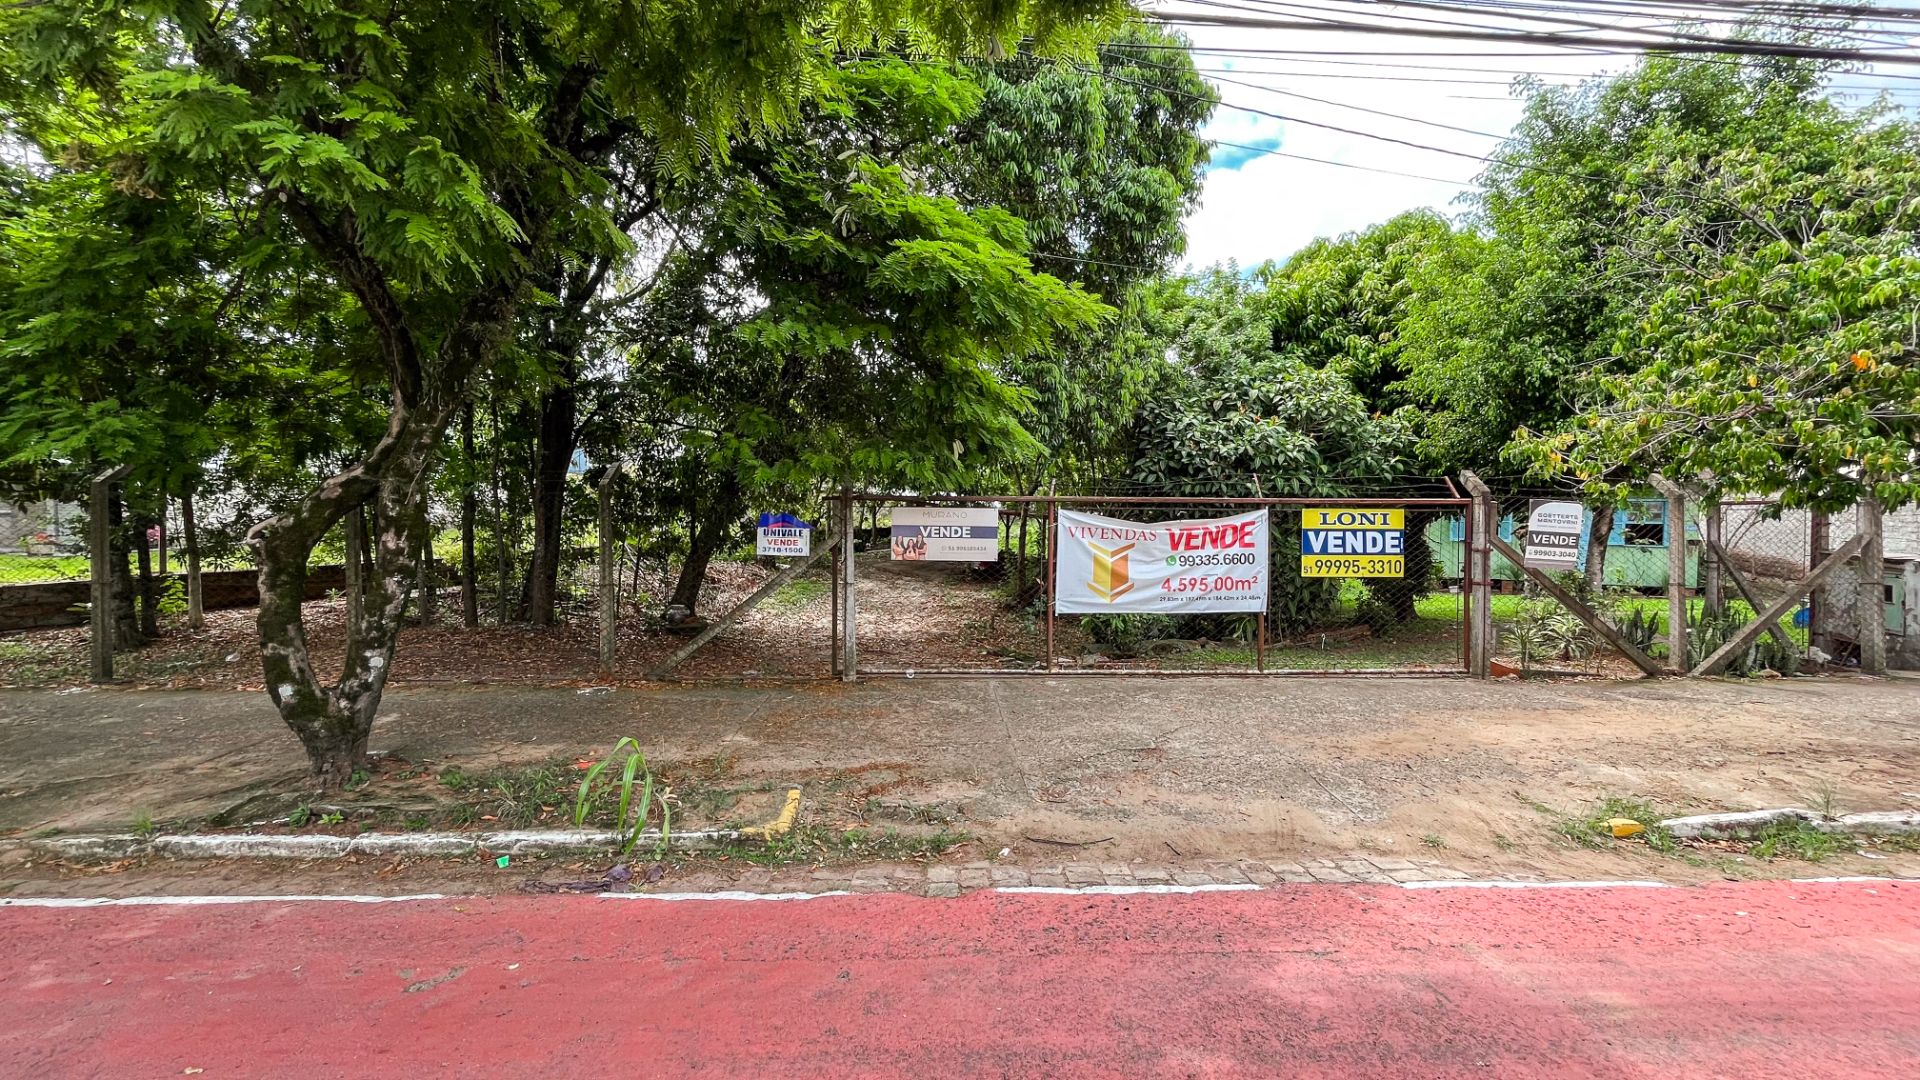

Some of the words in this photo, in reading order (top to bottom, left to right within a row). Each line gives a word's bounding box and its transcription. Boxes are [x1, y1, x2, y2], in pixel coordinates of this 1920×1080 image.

[922, 511, 968, 519] MURANO
[1319, 512, 1390, 526] LONI
[763, 528, 804, 537] UNIVALE
[920, 526, 971, 538] VENDE
[1067, 526, 1157, 542] VIVENDAS
[1165, 521, 1256, 551] VENDE
[1307, 531, 1400, 553] VENDE
[1532, 533, 1577, 546] VENDE
[1179, 553, 1255, 567] 99335.6600
[1303, 566, 1313, 574] 51
[1314, 559, 1402, 574] 99995-3310
